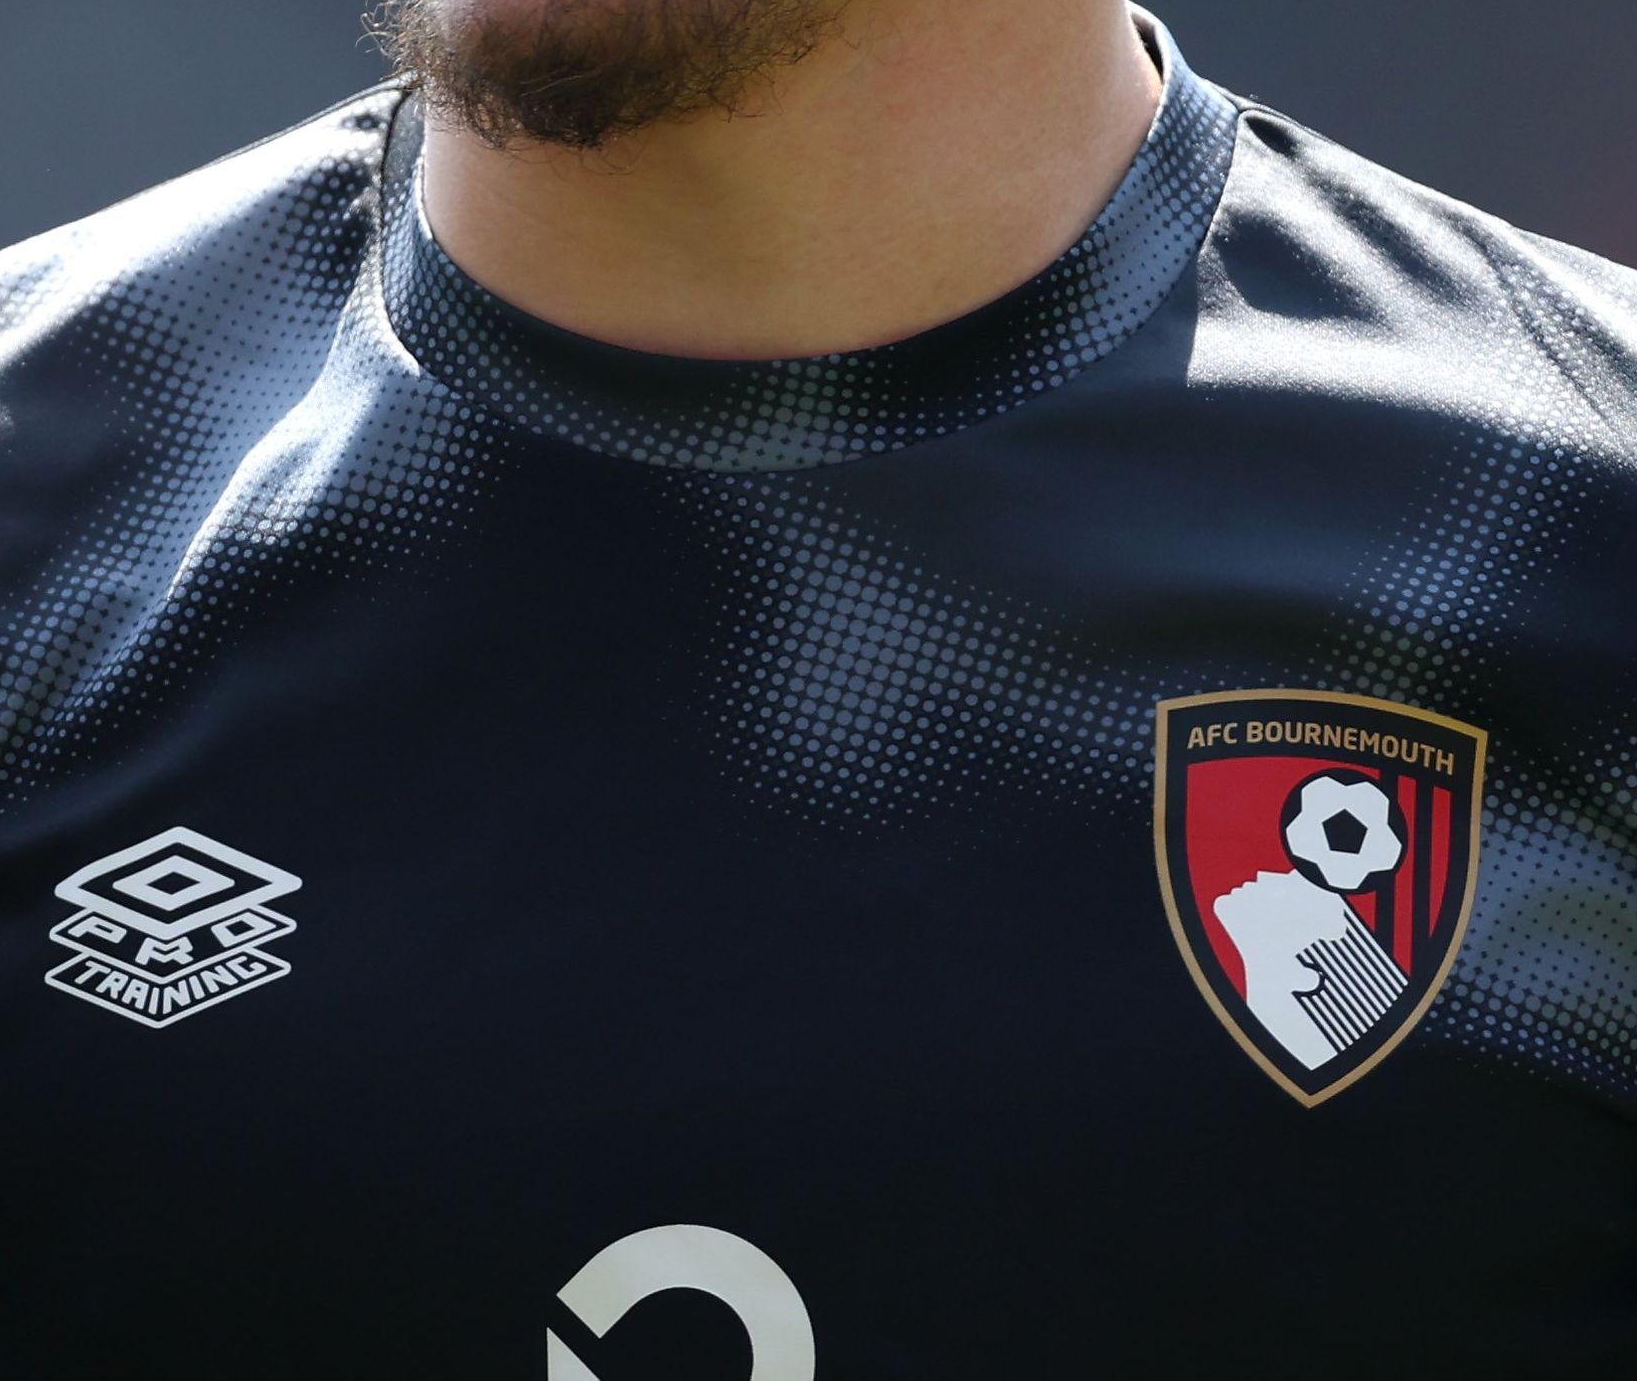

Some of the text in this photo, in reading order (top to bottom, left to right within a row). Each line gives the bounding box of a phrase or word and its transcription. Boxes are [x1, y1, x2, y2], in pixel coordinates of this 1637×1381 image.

[1186, 720, 1455, 776] AFC BOURNEMOUTH
[67, 911, 277, 966] PRO
[74, 955, 267, 1015] TRAINING
